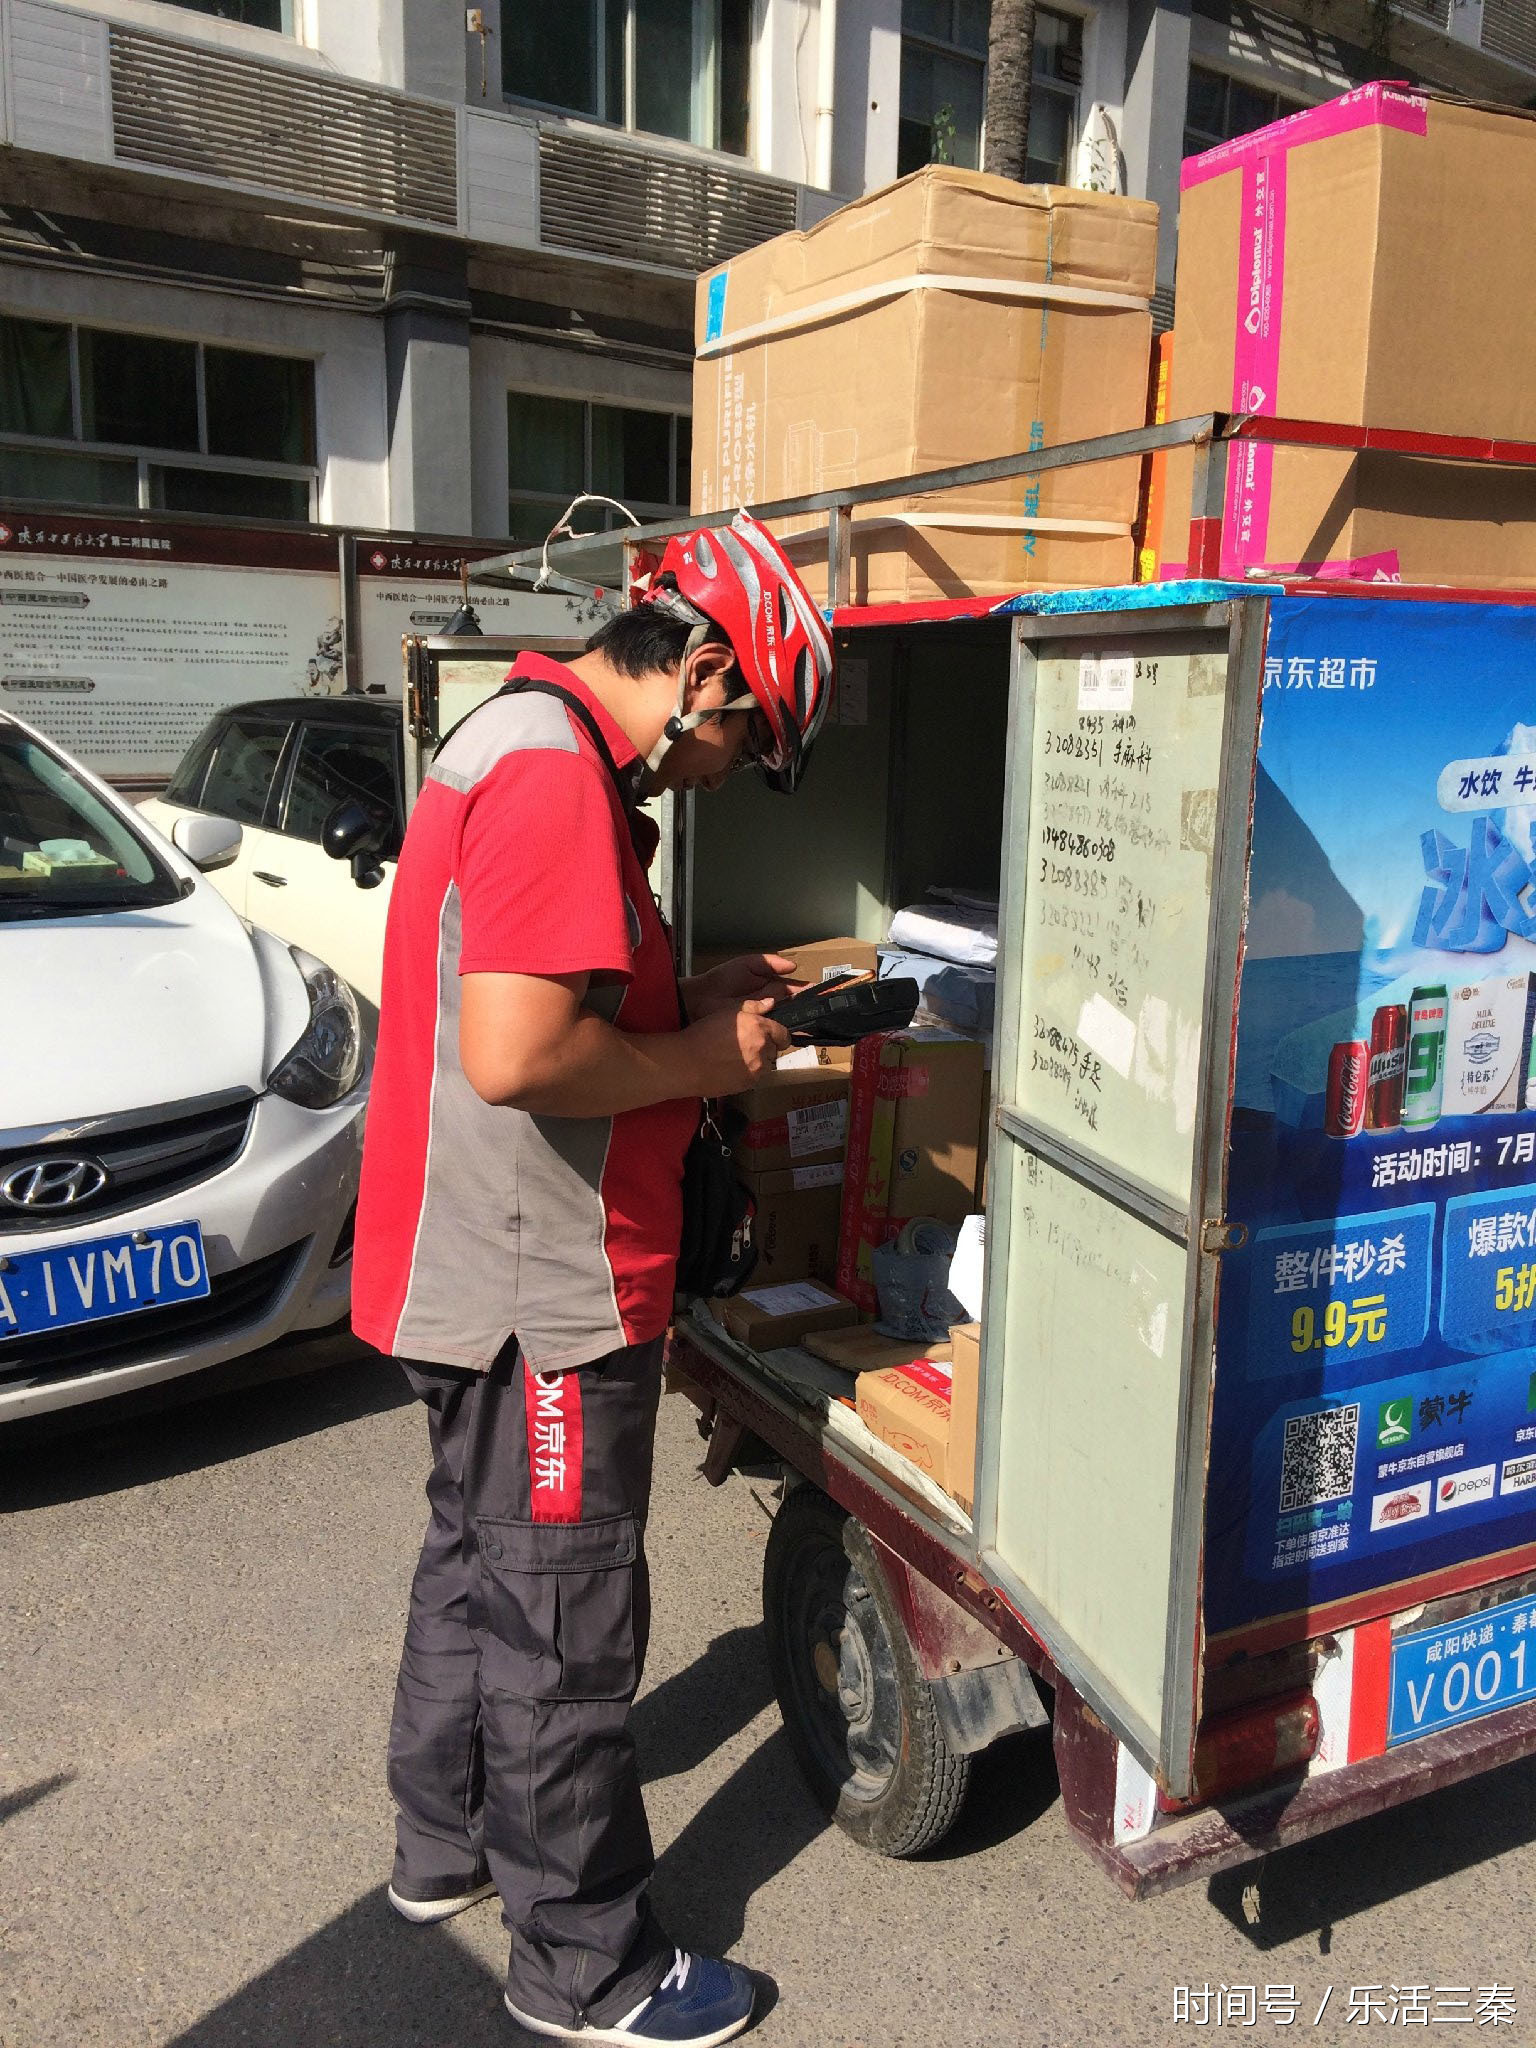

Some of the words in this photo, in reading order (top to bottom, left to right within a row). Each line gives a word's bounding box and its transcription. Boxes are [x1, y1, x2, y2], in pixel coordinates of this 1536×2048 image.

[1264, 656, 1378, 691] 京东超市
[1458, 769, 1502, 799] 水饮
[1513, 764, 1536, 793] 牛
[1273, 1232, 1406, 1294] 整件秒杀
[1290, 1294, 1388, 1353] 9.9元
[1419, 1389, 1474, 1432] 蒙牛
[1377, 1443, 1465, 1479] 蒙牛京东自营旗舰店
[1457, 1474, 1492, 1496] pepsi
[1272, 1537, 1349, 1569] 指定时间送到家
[1274, 1522, 1351, 1554] 下单使用京准达
[1406, 1640, 1526, 1724] V001
